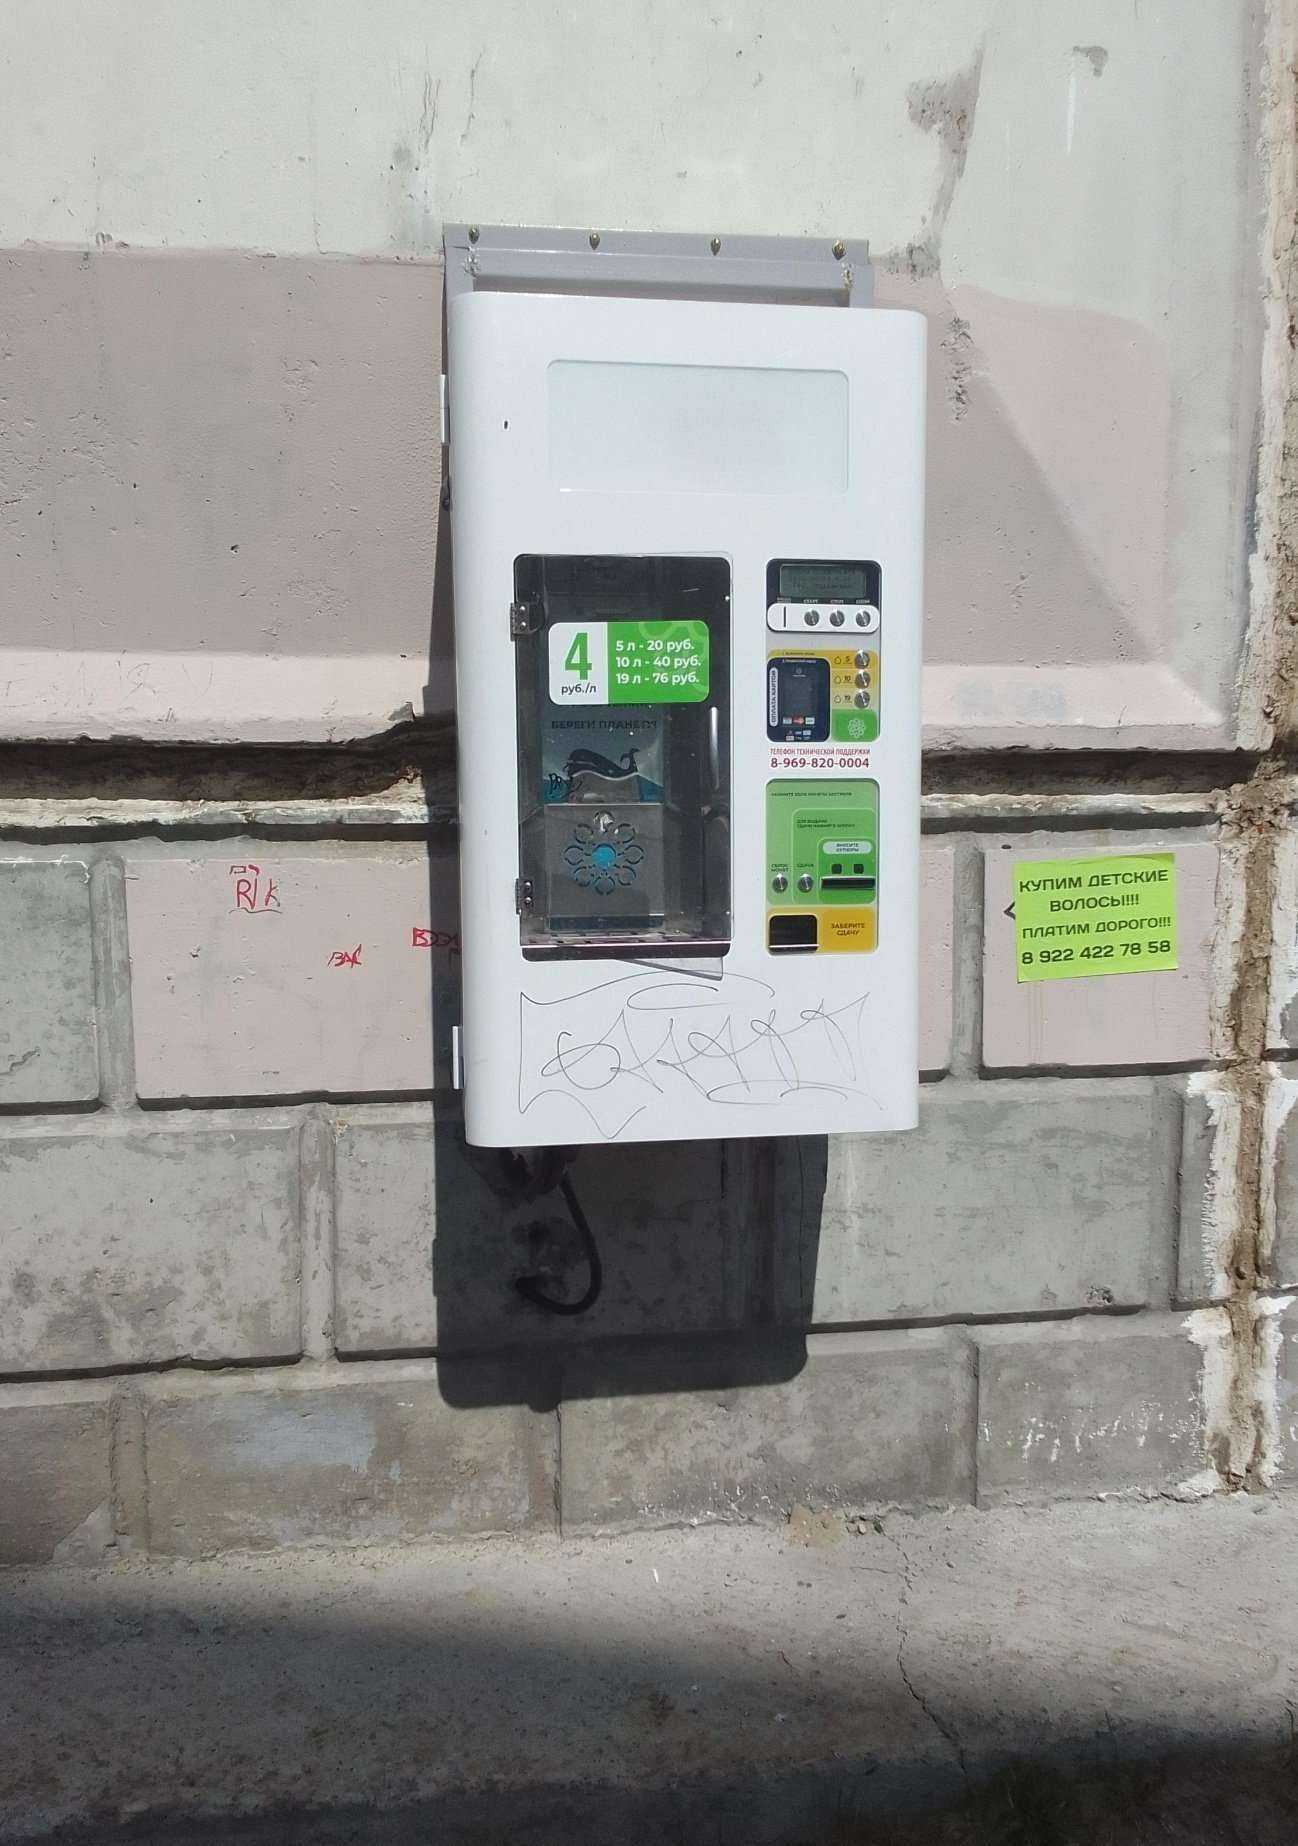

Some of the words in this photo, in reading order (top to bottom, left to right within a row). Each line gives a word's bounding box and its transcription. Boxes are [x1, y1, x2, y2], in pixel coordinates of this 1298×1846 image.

[616, 640, 624, 651] 5
[627, 642, 635, 651] л
[647, 640, 664, 651] 20
[667, 639, 695, 652] руб.
[565, 632, 592, 680] 4
[616, 657, 630, 667] 10
[633, 658, 642, 667] л
[653, 656, 670, 667] 40
[674, 655, 701, 668] руб.
[616, 673, 629, 684] 19
[632, 674, 641, 684] л
[652, 673, 668, 684] 76
[672, 672, 699, 685] руб.
[561, 683, 597, 695] руб./л
[770, 757, 870, 768] 8-969-820-0004
[1019, 876, 1082, 893] КУПИМ
[1088, 869, 1169, 887] ДЕТСКИЕ
[1050, 893, 1139, 912] ВОЛОСЫ!!!
[1022, 923, 1090, 939] ПЛАТИМ
[1095, 916, 1171, 933] ДОРОГО!!!
[1021, 951, 1034, 964] 8
[1039, 949, 1074, 963] 922
[1079, 945, 1114, 960] 422
[1120, 942, 1142, 956] 78
[1147, 940, 1171, 953] 58
